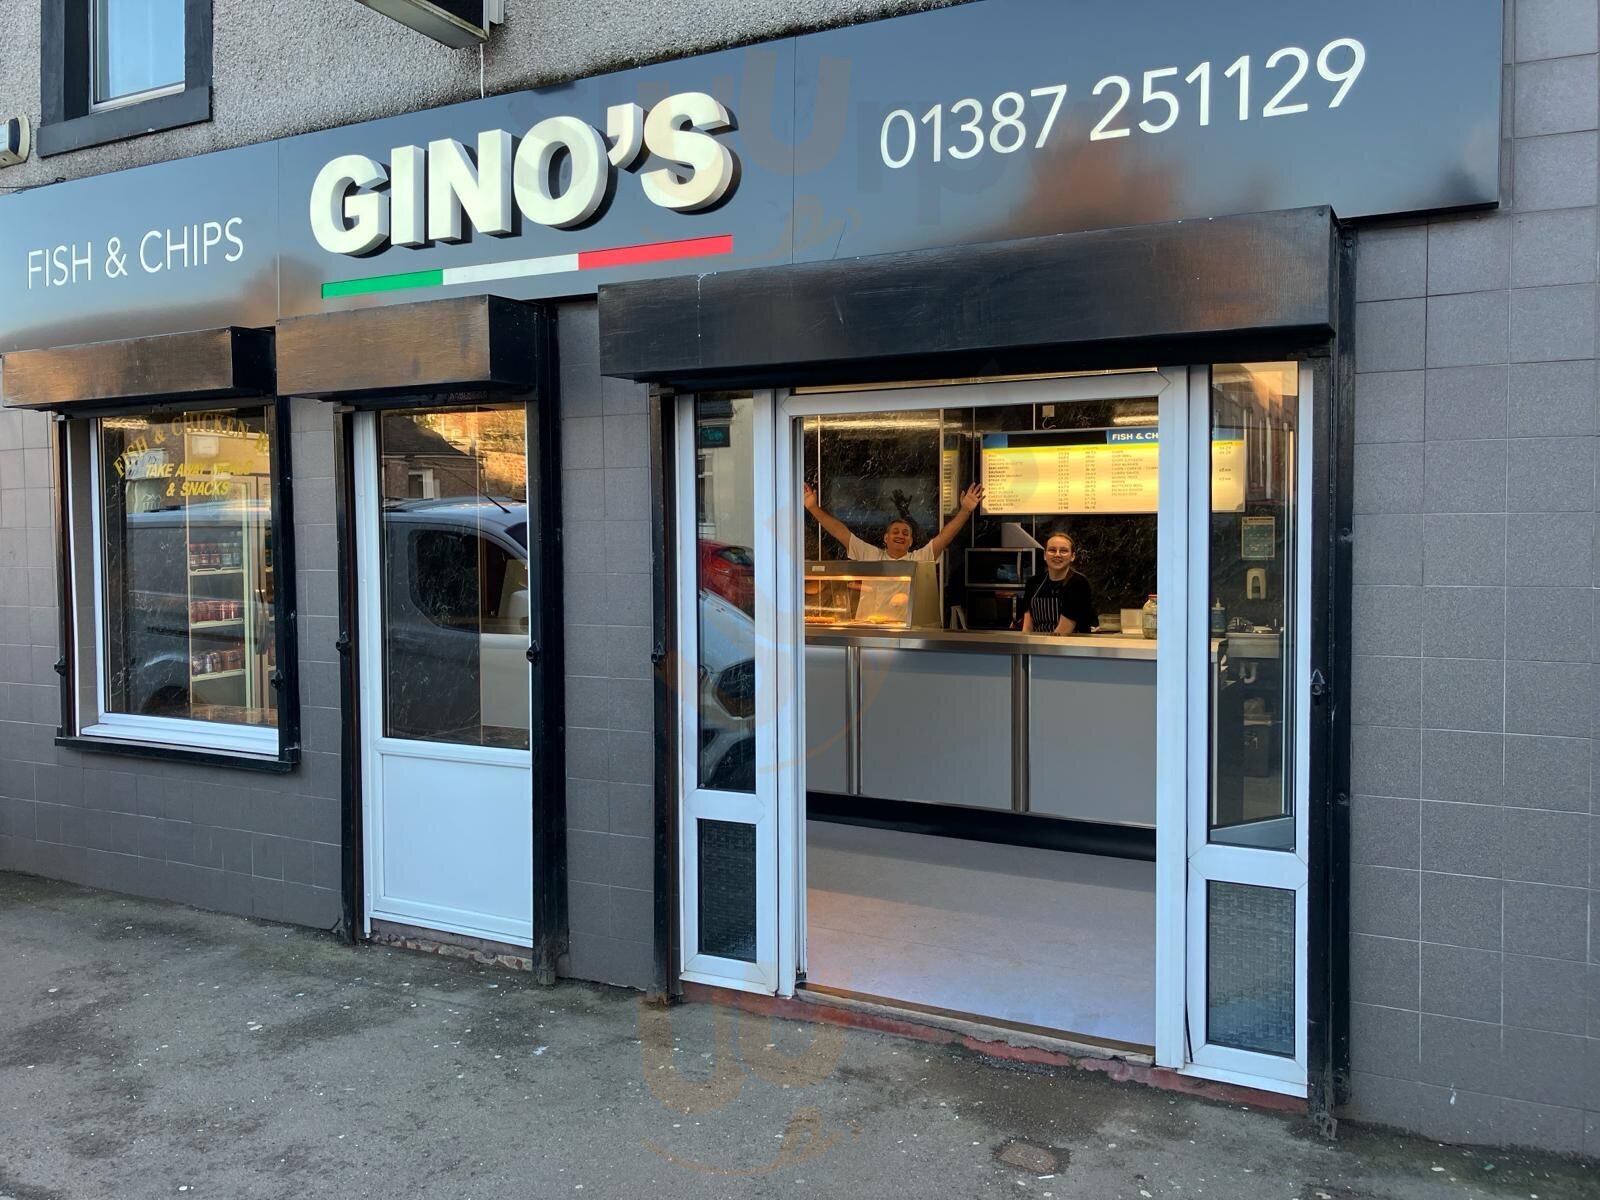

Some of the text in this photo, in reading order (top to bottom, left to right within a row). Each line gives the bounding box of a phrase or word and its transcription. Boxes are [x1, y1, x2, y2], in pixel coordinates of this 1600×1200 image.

[880, 37, 1367, 169] 01387 251129
[309, 91, 732, 256] GINO'S
[28, 216, 245, 290] FISH & CHIPS
[113, 436, 149, 478] FISH
[171, 412, 249, 438] CHICKEN
[1112, 433, 1134, 441] FISH
[1135, 432, 1144, 440] &
[146, 463, 175, 478] TAKE
[166, 481, 231, 497] & SNACKS
